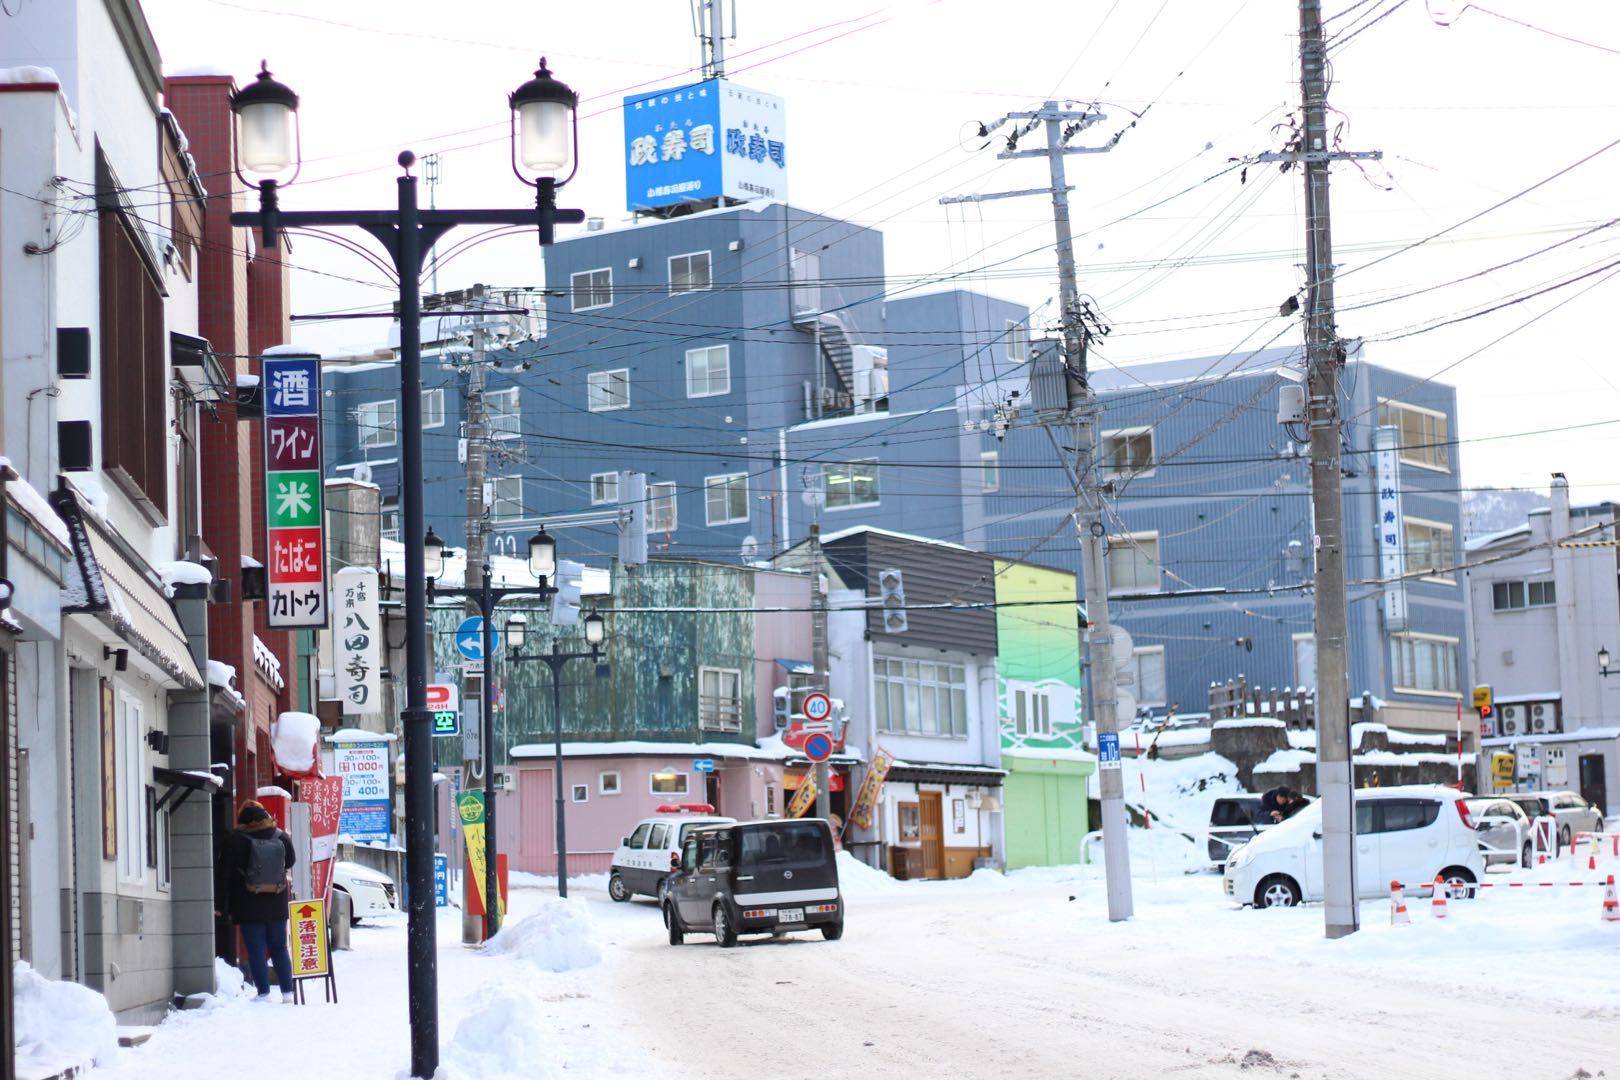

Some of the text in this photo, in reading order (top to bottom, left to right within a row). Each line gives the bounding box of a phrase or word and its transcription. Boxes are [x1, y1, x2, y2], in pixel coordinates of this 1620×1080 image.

[630, 124, 714, 166] 政寿司
[726, 128, 785, 168] 政寿司
[273, 369, 310, 407] 酒
[271, 426, 315, 460] ワイン
[275, 481, 312, 519] 米
[274, 538, 317, 574] たばこ
[271, 589, 320, 617] カトウ
[434, 711, 455, 731] 空
[809, 700, 826, 714] 40
[331, 780, 340, 820] もらって
[299, 920, 319, 971] 落雪注意
